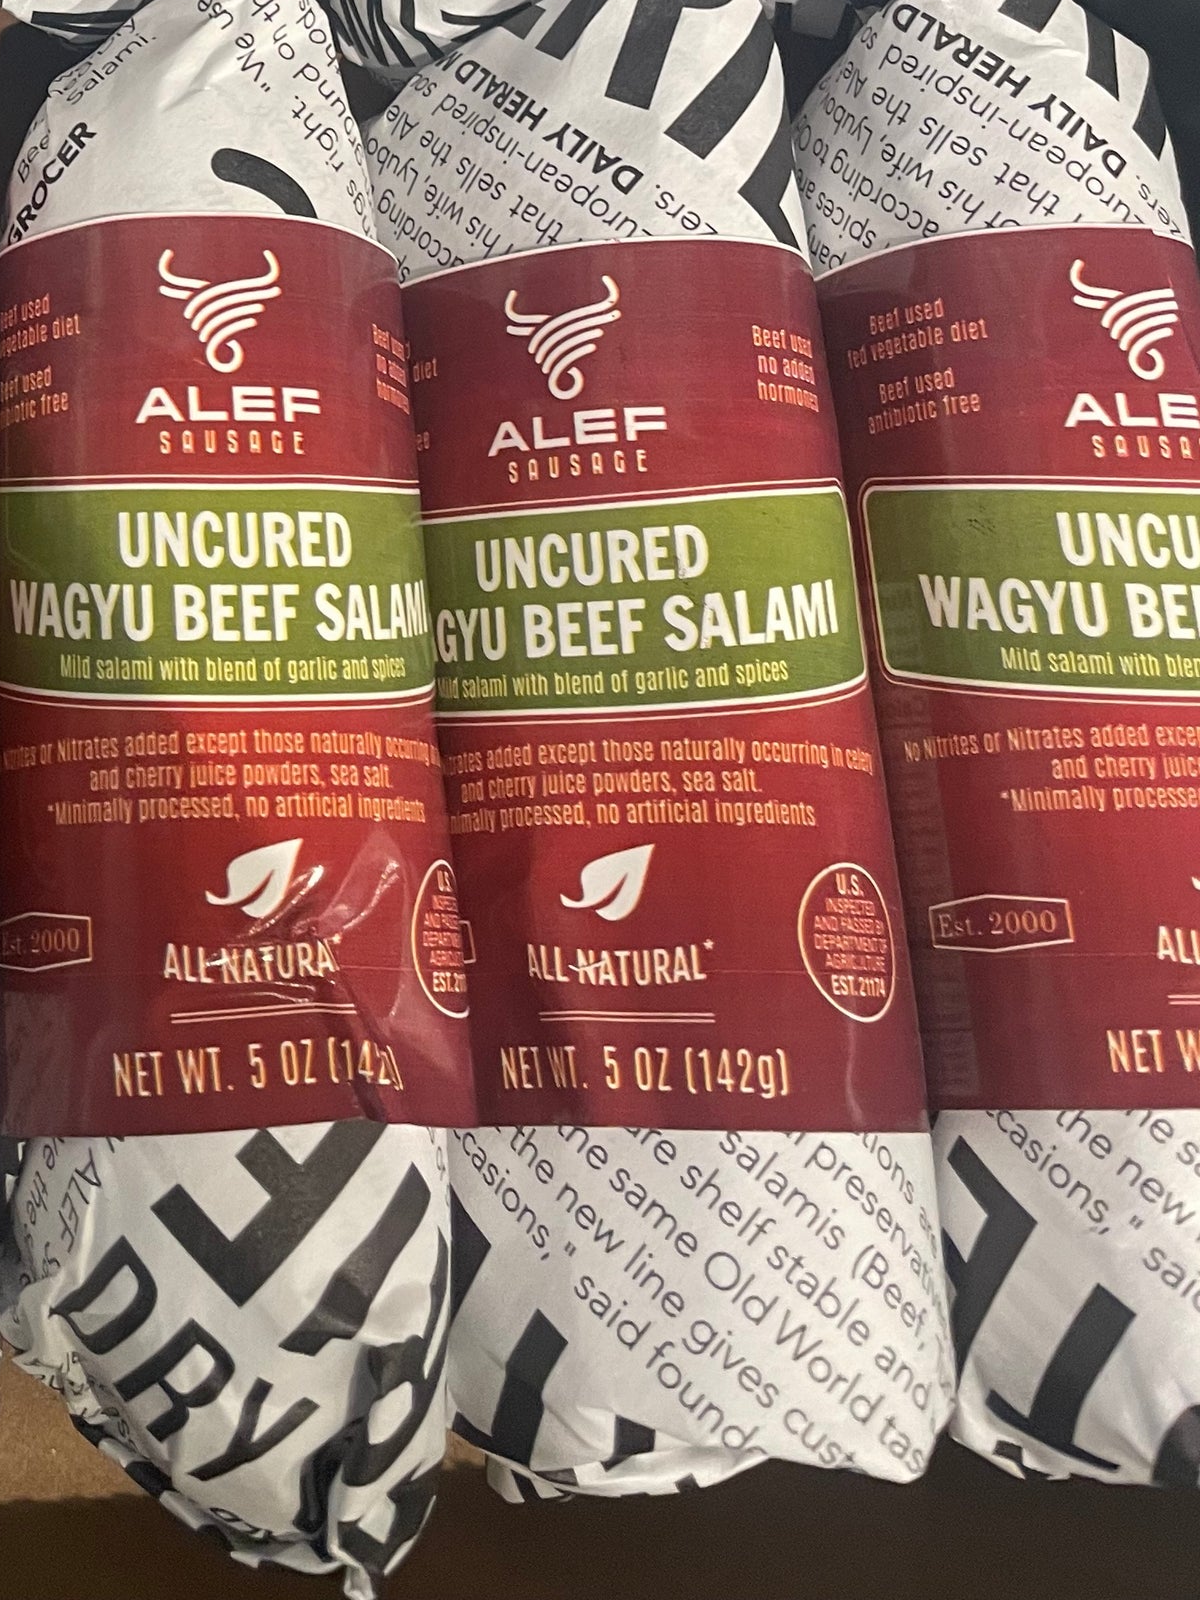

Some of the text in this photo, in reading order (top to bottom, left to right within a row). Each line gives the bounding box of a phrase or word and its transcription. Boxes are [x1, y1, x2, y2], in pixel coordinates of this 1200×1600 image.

[892, 4, 1128, 179] DAILY HERALD
[454, 59, 645, 195] DAILY HERALD
[7, 122, 96, 246] GROCER
[869, 297, 944, 335] Beef used
[871, 318, 989, 362] vegetable diet
[135, 385, 322, 424] ALEF
[488, 405, 668, 458] ALEF
[942, 392, 981, 417] free
[159, 430, 305, 456] SAUSAGE
[117, 510, 353, 570] UNCURED
[474, 523, 709, 593] UNCURED
[9, 579, 430, 643] WAGYU BEEF SALAMI
[522, 578, 839, 660] BEEF SALAMI
[918, 573, 1110, 638] WAGYU
[125, 731, 383, 758] added except those naturally
[1006, 724, 1150, 752] Nitrates added
[939, 910, 1058, 938] Est. 2000
[1106, 1029, 1162, 1075] NET
[679, 1164, 871, 1347] shelf stable
[51, 1235, 321, 1482] DRY
[703, 1250, 886, 1425] Old World
